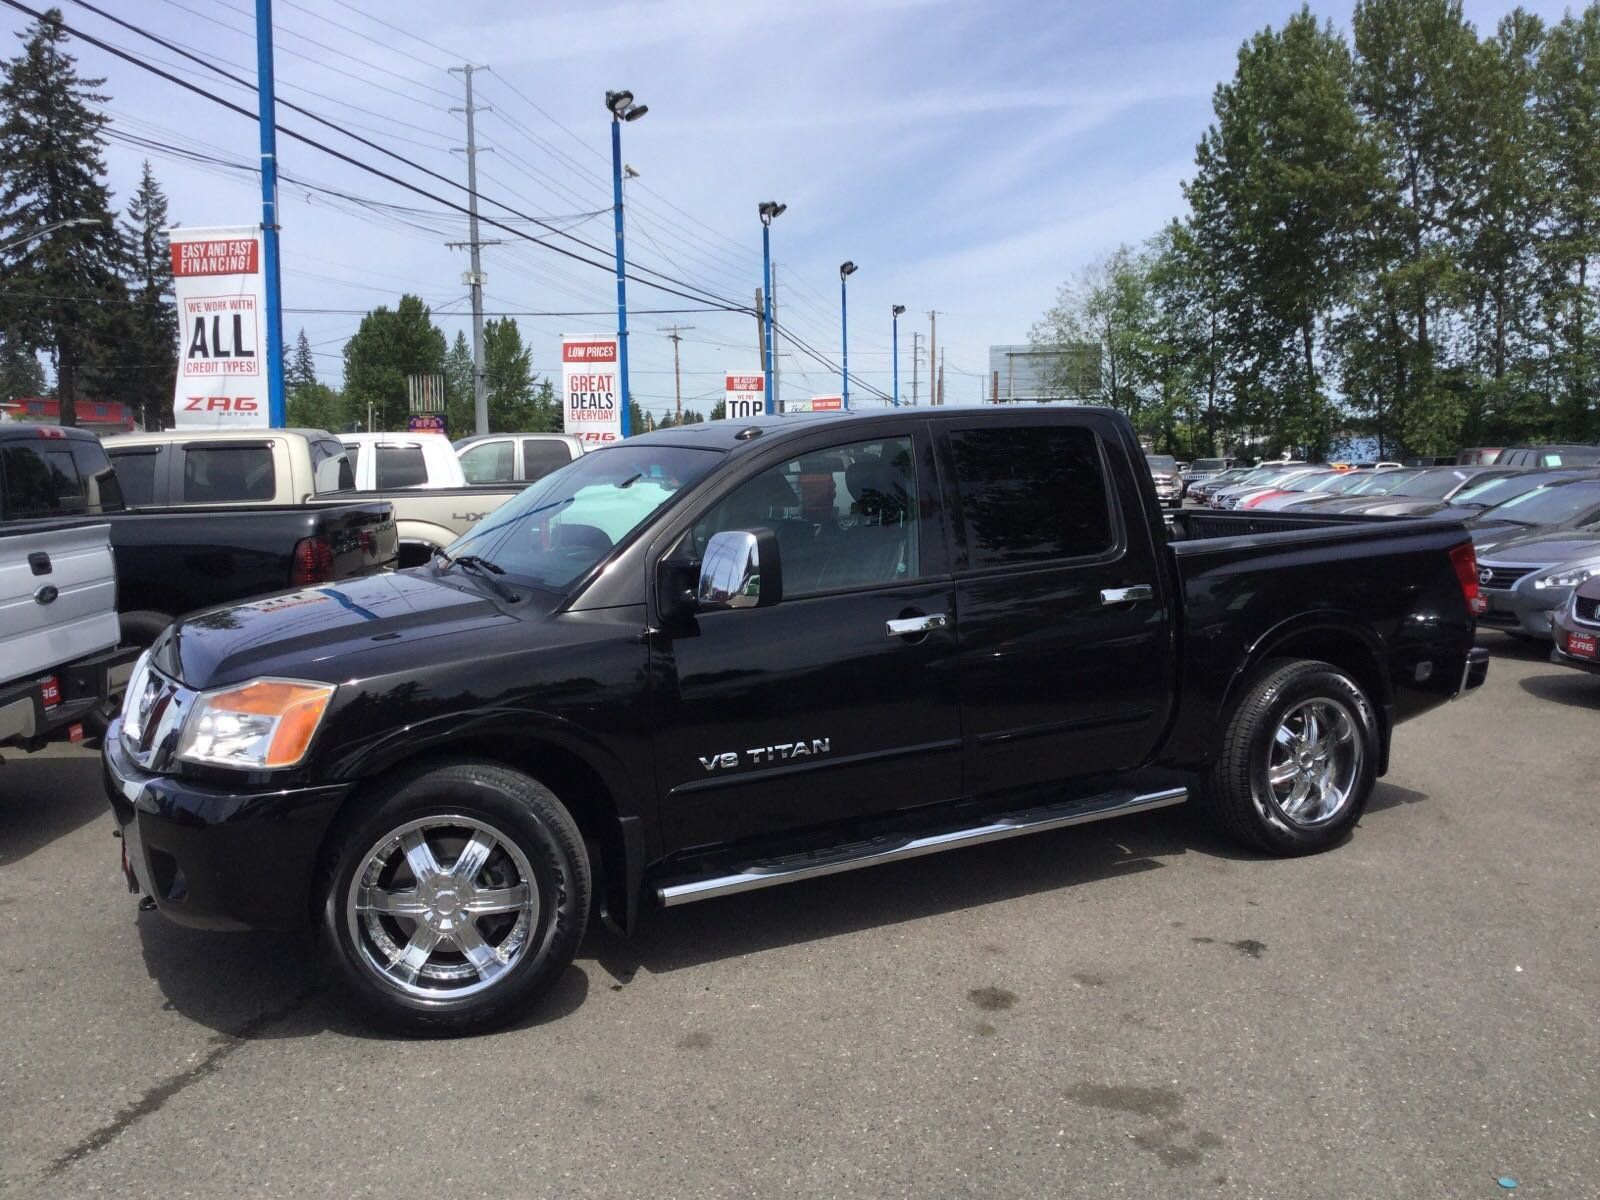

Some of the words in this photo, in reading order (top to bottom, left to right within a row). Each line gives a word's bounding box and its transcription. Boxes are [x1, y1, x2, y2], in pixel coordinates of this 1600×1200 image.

[181, 244, 205, 257] EASY
[207, 242, 227, 257] AND
[229, 241, 253, 256] FAST
[181, 256, 250, 273] FINANCING!
[188, 302, 203, 313] WE
[205, 301, 227, 312] WORK
[230, 299, 253, 311] WITH
[188, 314, 255, 358] ALL
[568, 347, 586, 358] LOW
[586, 347, 614, 357] PRICES
[186, 362, 218, 374] CREDIT
[222, 361, 257, 373] TYPES!
[571, 376, 612, 392] GREAT
[184, 397, 258, 411] ZAG
[571, 393, 614, 409] DEALS
[729, 400, 763, 418] TOP
[571, 409, 614, 421] EVERYDAY
[1570, 640, 1593, 651] ZAG
[699, 752, 738, 770] V8
[747, 738, 830, 763] TITAN
